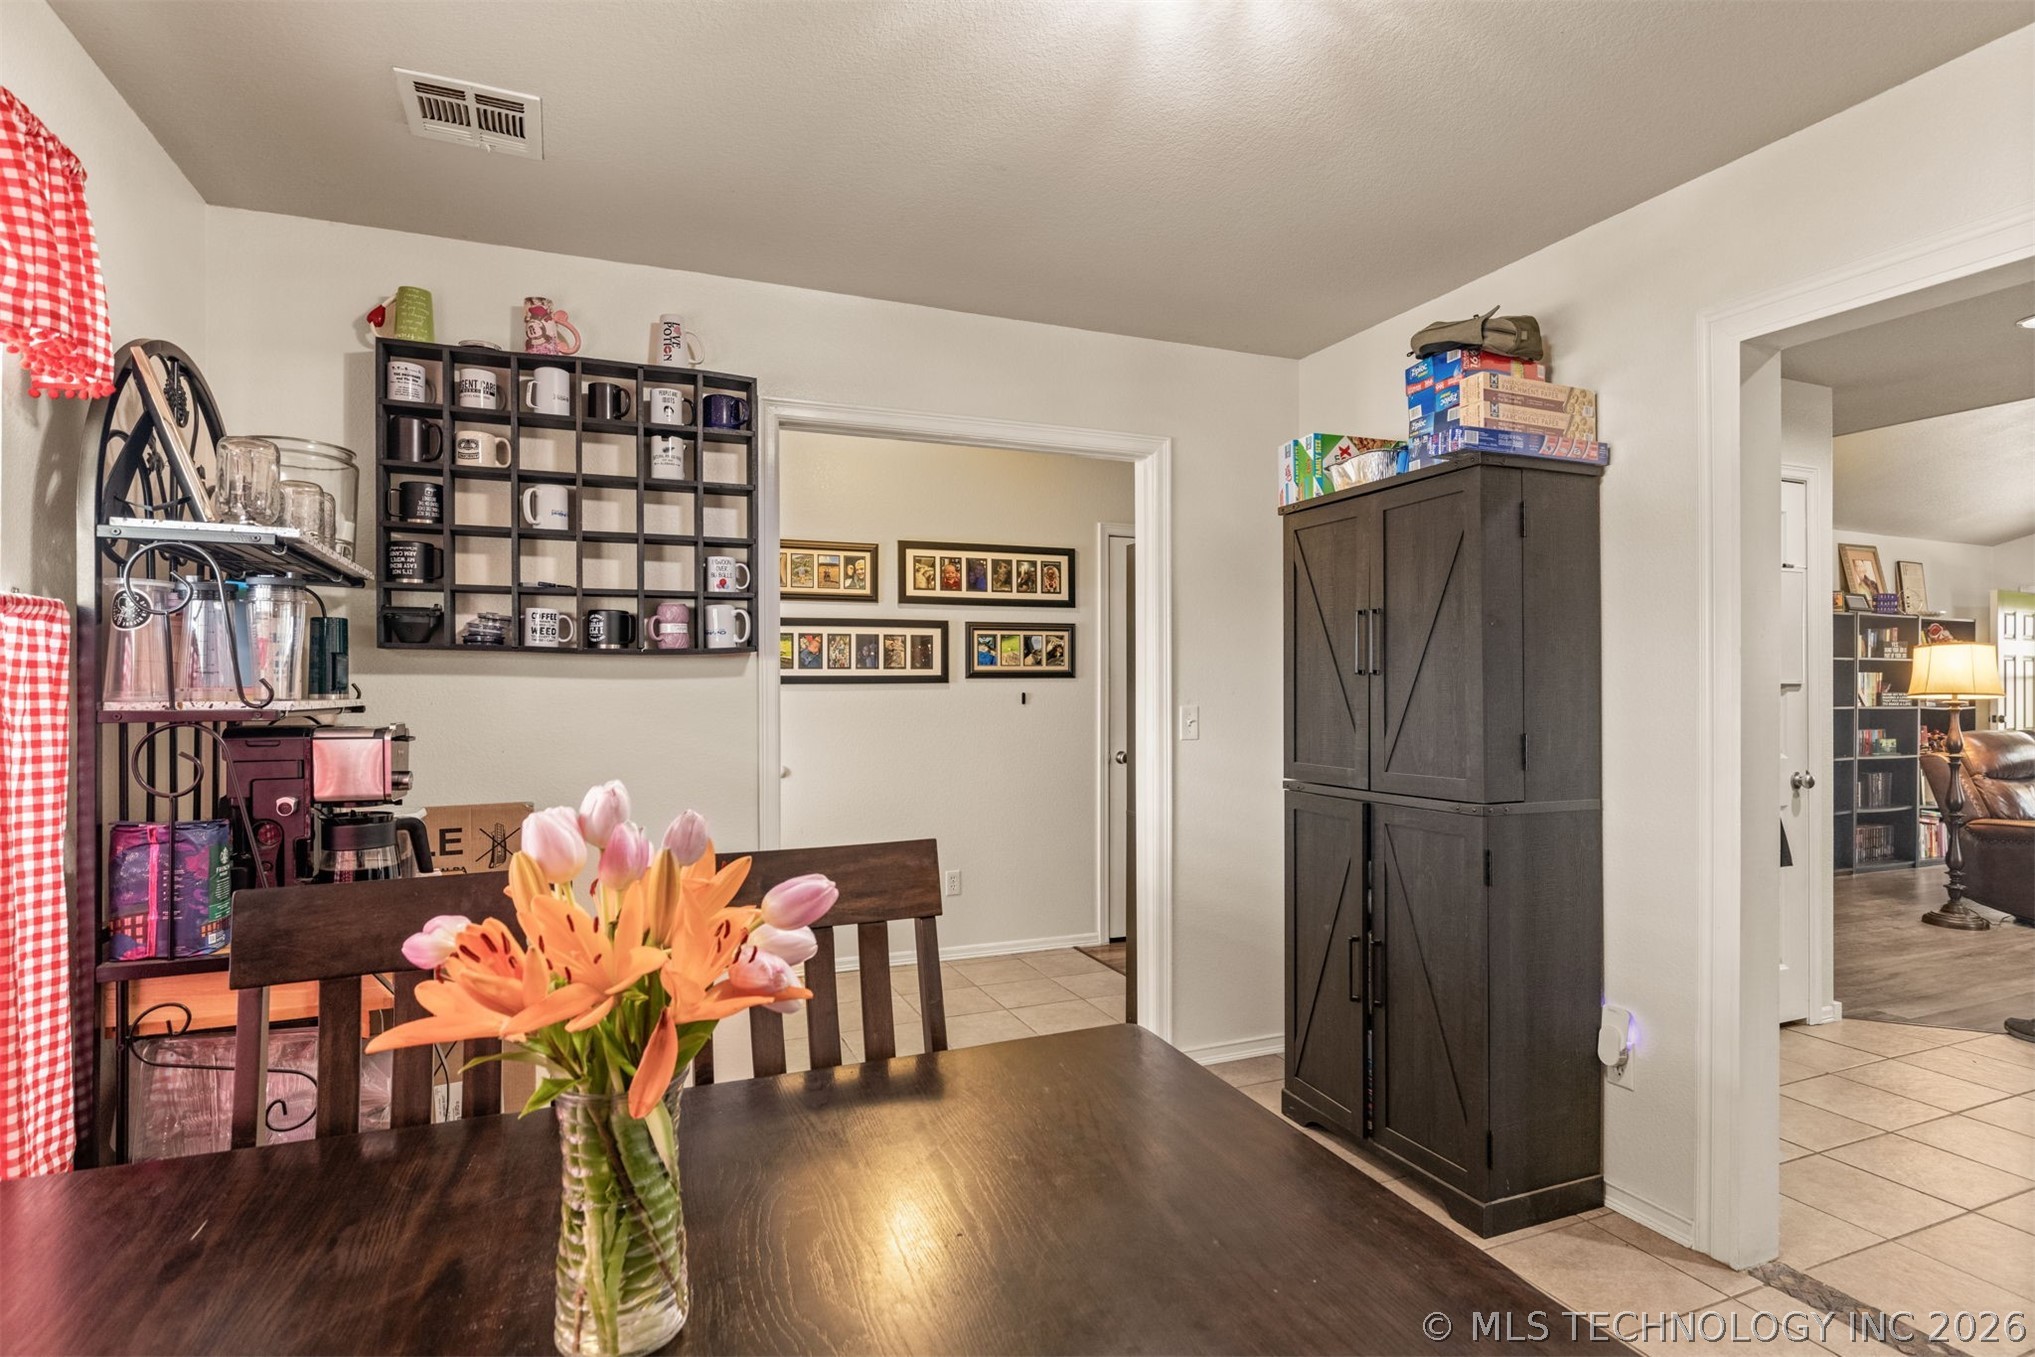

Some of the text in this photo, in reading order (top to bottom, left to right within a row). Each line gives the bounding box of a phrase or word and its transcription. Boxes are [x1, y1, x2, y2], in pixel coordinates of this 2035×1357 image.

[1502, 383, 1539, 396] PARCHMENT
[1541, 391, 1559, 399] PAPER
[1502, 412, 1539, 424] PARCHMENT
[1541, 418, 1559, 427] PAPER
[531, 612, 557, 621] COFFEE
[531, 626, 557, 635] WEED
